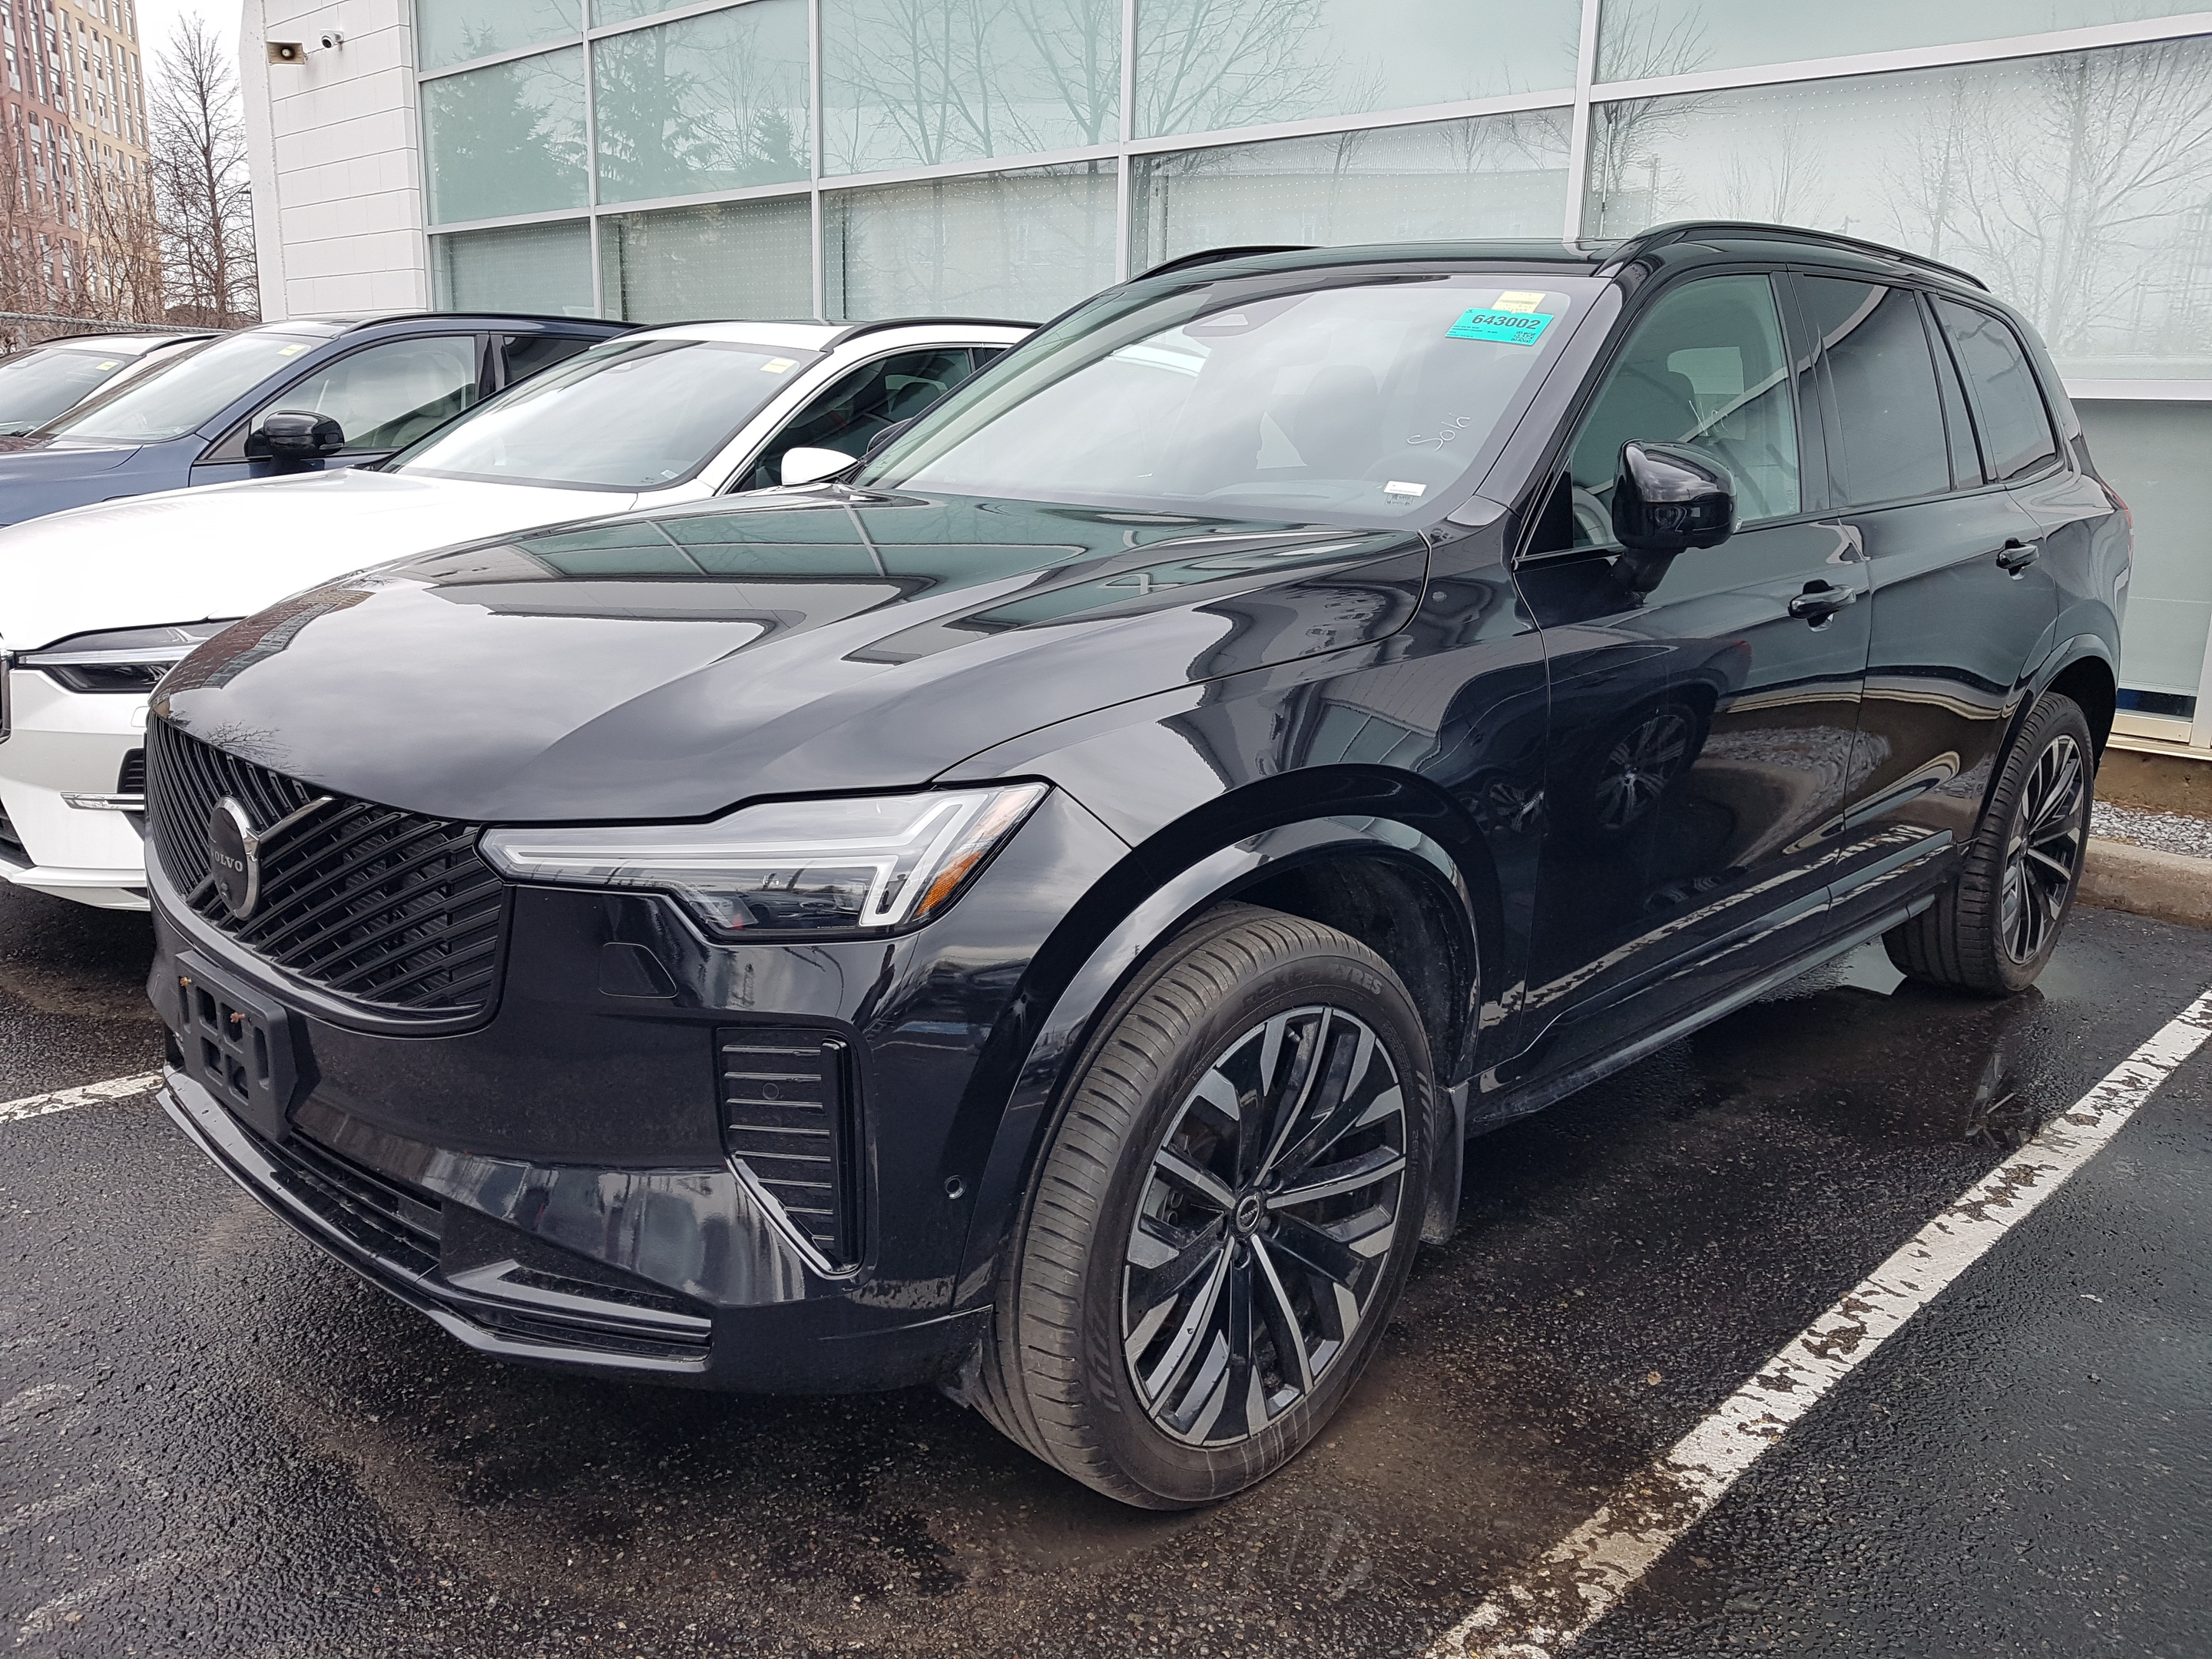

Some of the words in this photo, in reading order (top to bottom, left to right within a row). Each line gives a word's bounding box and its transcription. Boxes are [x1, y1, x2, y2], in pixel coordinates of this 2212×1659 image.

[1472, 313, 1541, 330] 643002
[210, 850, 243, 873] OLVO
[1329, 962, 1382, 995] TYRES
